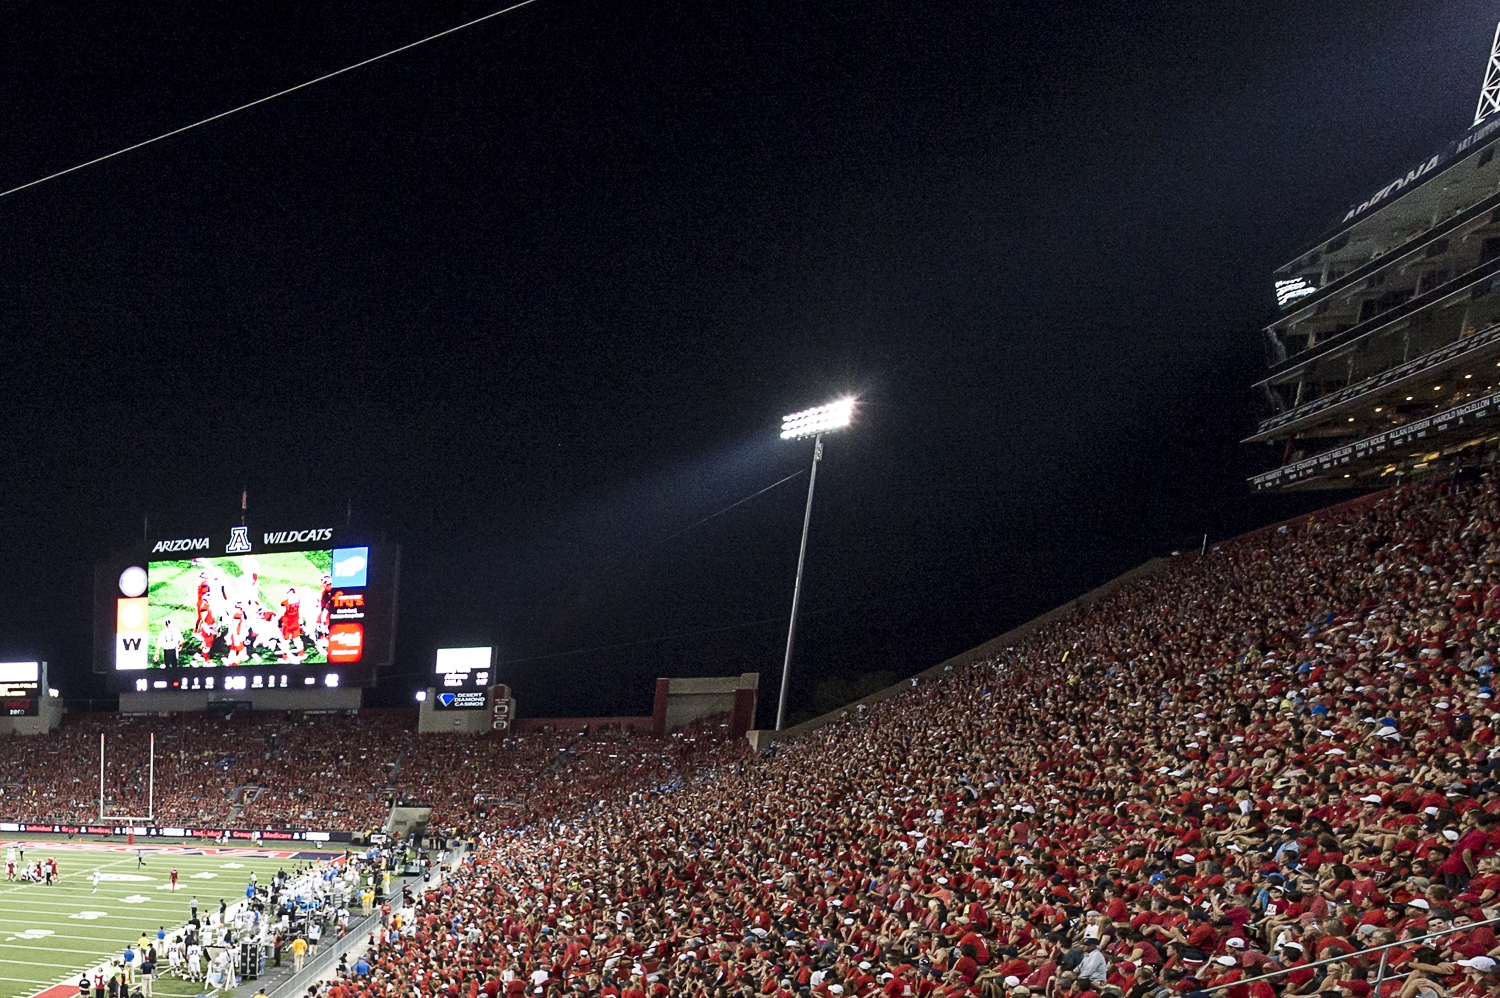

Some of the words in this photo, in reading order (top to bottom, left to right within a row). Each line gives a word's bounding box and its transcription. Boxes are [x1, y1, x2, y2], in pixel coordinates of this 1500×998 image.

[152, 538, 210, 553] ARIZONA
[226, 527, 251, 553] A
[263, 528, 333, 544] WILDCATS
[123, 638, 142, 651] W
